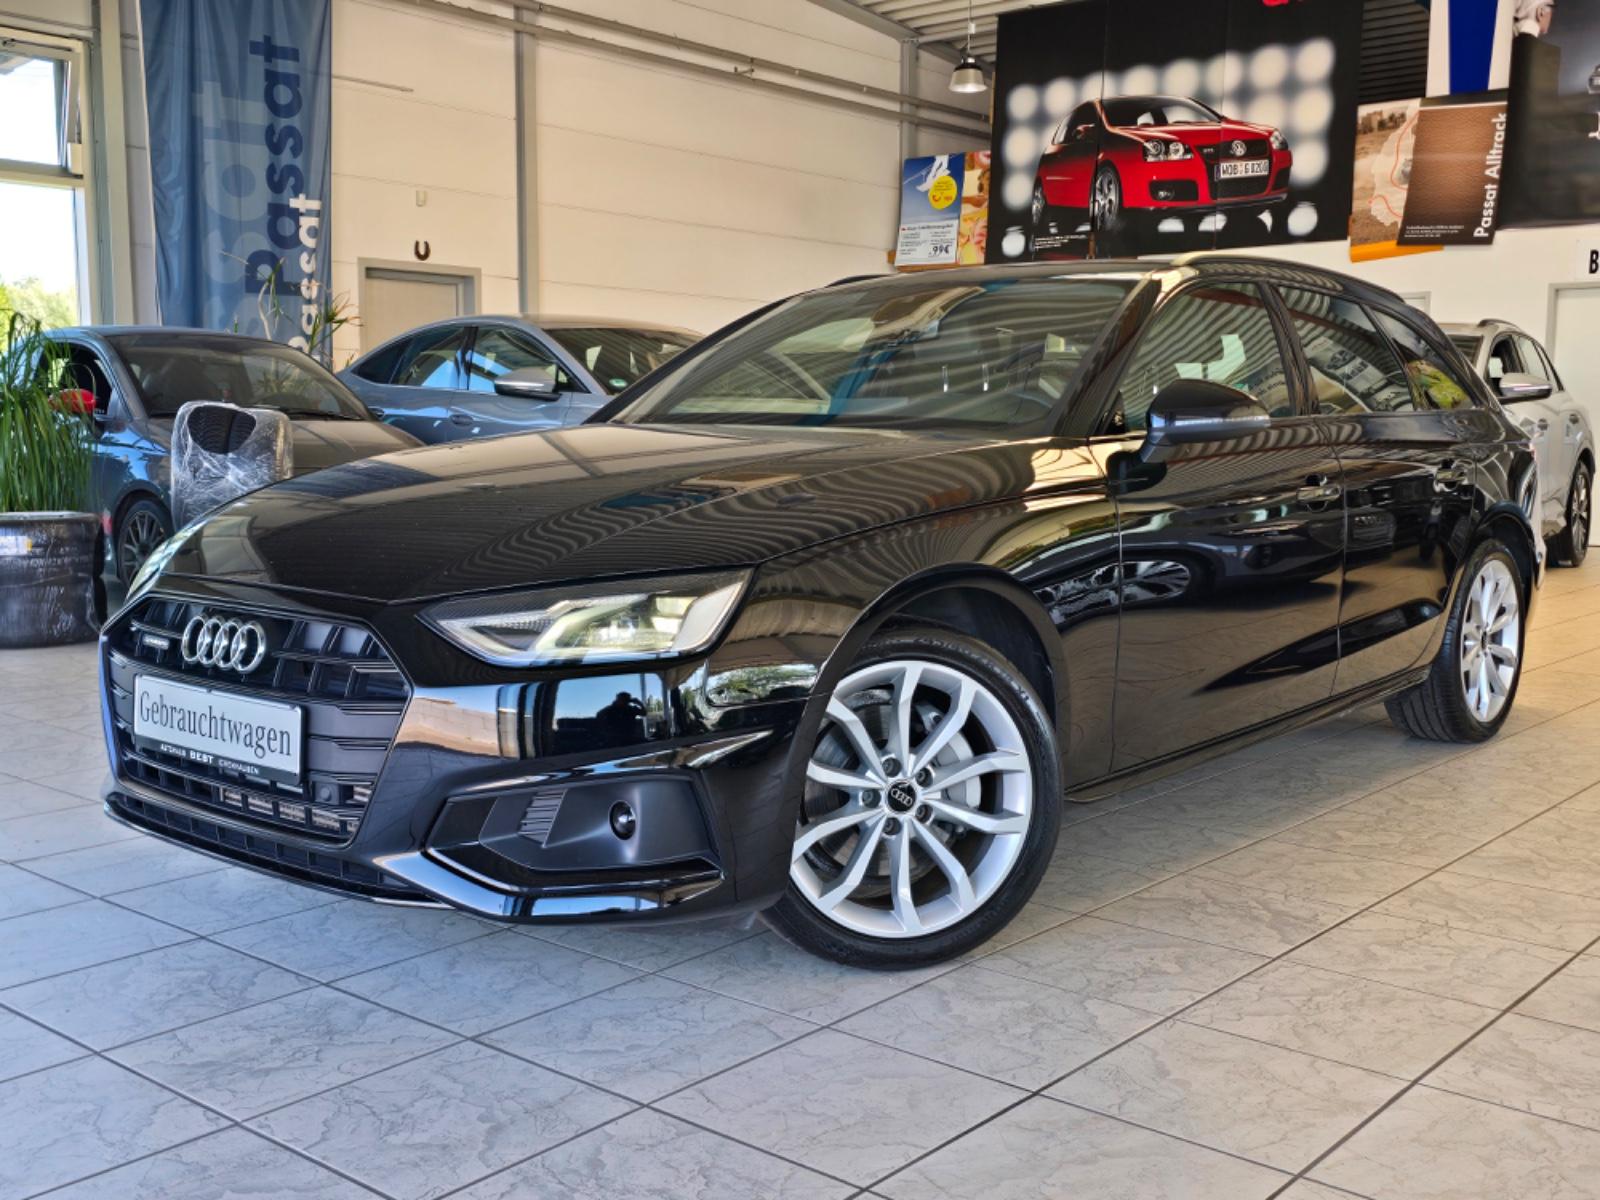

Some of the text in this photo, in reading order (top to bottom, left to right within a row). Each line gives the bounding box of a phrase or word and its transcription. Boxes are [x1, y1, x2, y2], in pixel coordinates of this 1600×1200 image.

[246, 35, 303, 296] Passat
[1473, 113, 1507, 238] Passat Alltrack
[140, 690, 292, 759] Gebrauchtwagen
[190, 749, 214, 764] BEST
